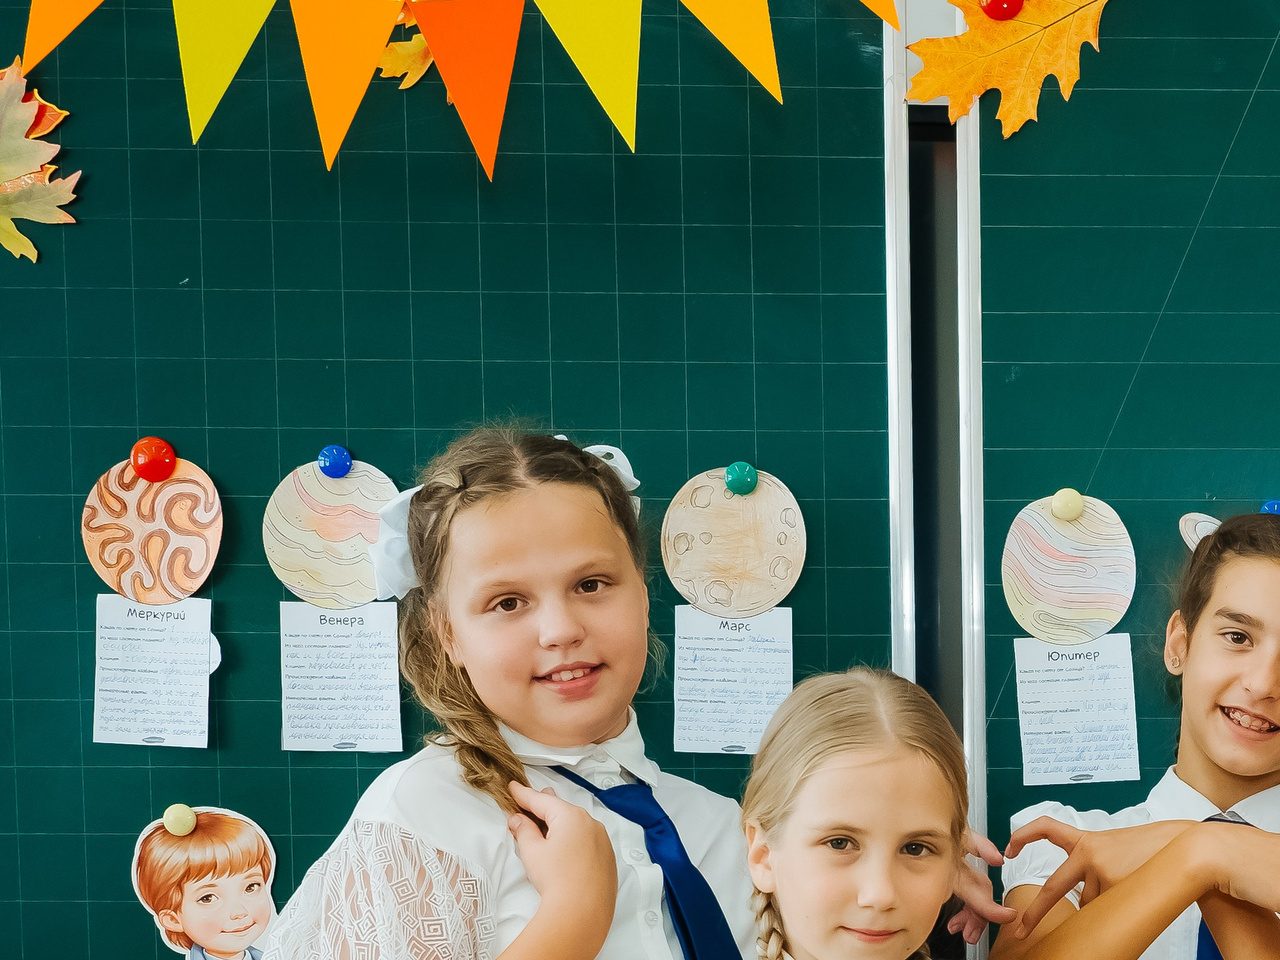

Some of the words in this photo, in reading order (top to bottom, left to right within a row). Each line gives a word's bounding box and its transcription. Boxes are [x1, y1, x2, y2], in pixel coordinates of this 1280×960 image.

[126, 608, 186, 622] Меркурий
[319, 614, 365, 627] Венера
[719, 620, 752, 632] Марс
[1047, 651, 1100, 662] Юпитер
